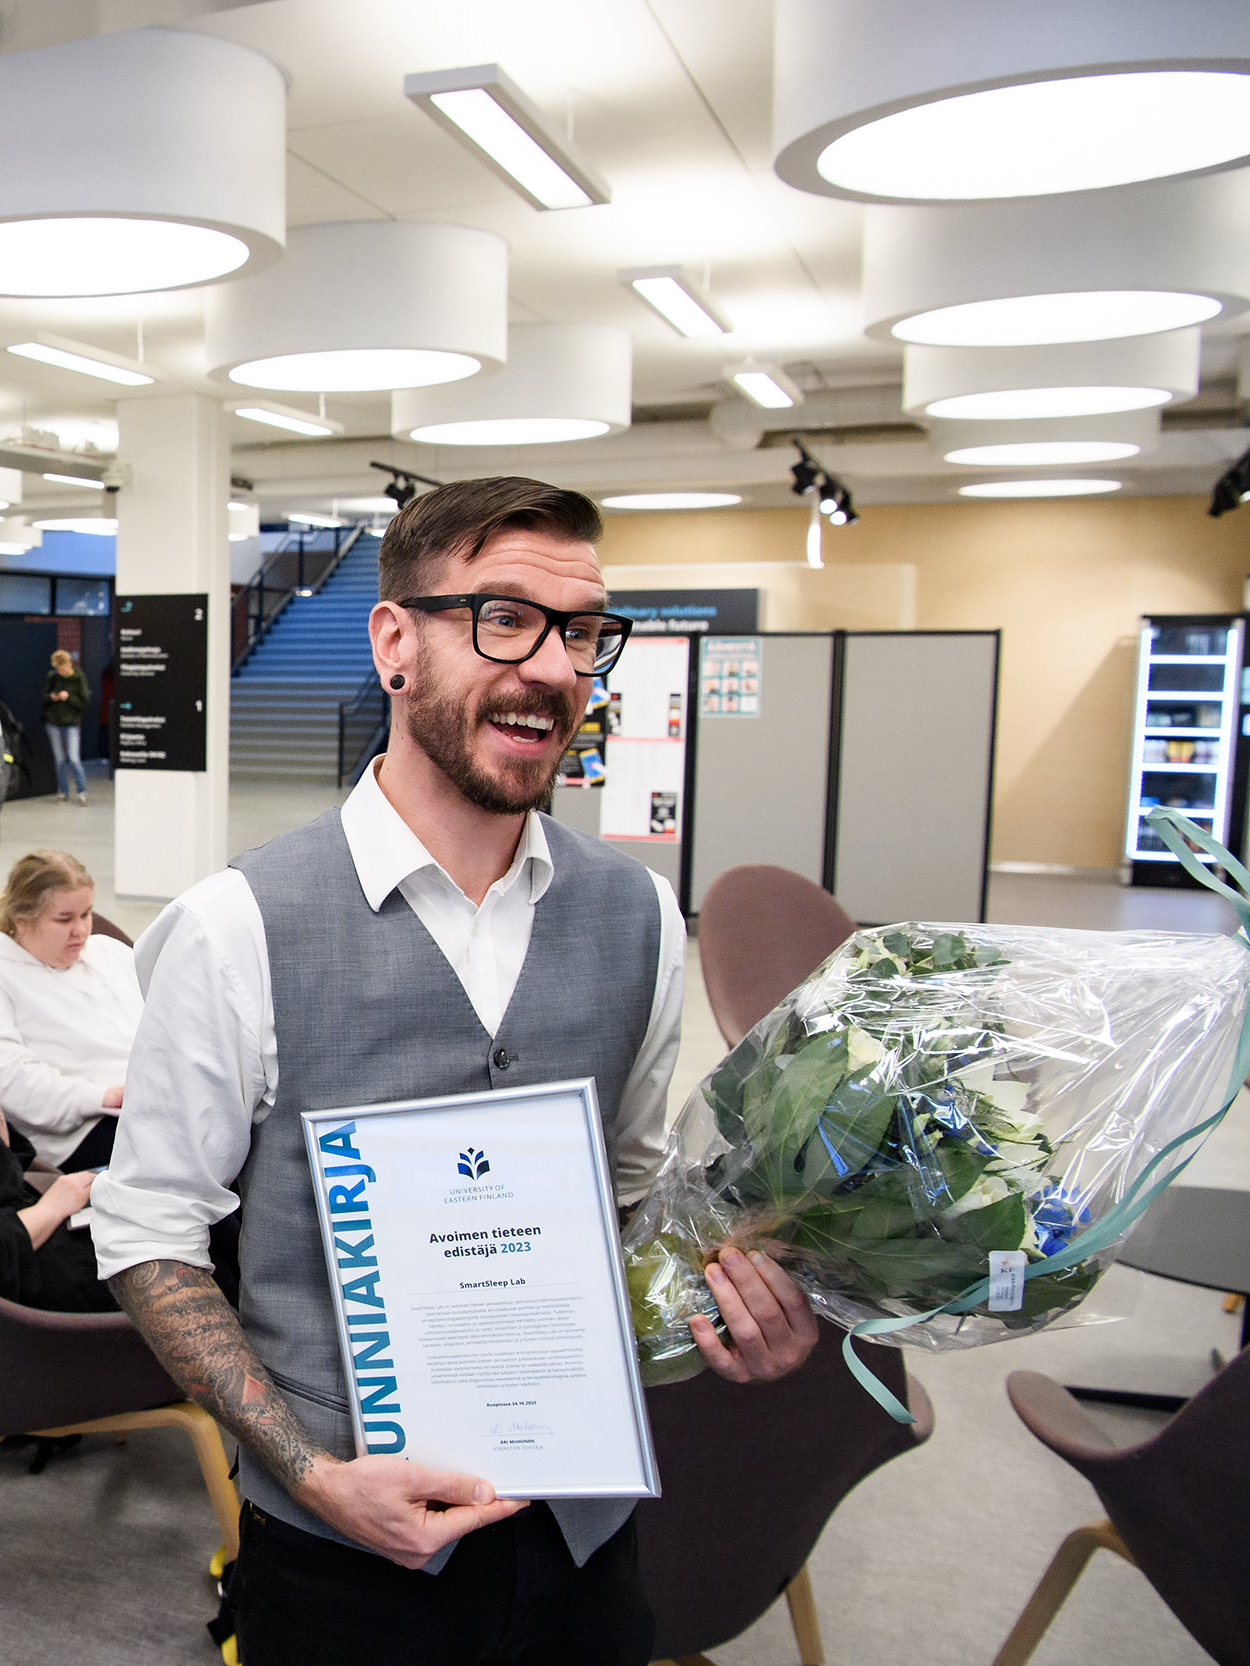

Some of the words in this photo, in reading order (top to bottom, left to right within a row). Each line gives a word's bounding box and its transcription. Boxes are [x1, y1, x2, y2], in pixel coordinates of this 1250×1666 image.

[194, 608, 203, 621] 2
[195, 700, 203, 712] 1
[449, 1185, 494, 1195] UNIVERSITY
[444, 1195, 478, 1204] EASTERN
[479, 1192, 514, 1200] FINLAND
[429, 1231, 489, 1244] Avoimen
[491, 1226, 542, 1239] tieteen
[443, 1243, 498, 1258] edistäjä
[500, 1241, 532, 1254] 2023
[459, 1280, 509, 1289] SmartSleep
[510, 1278, 526, 1286] Lab
[319, 1121, 408, 1460] UNNIAKIRJA
